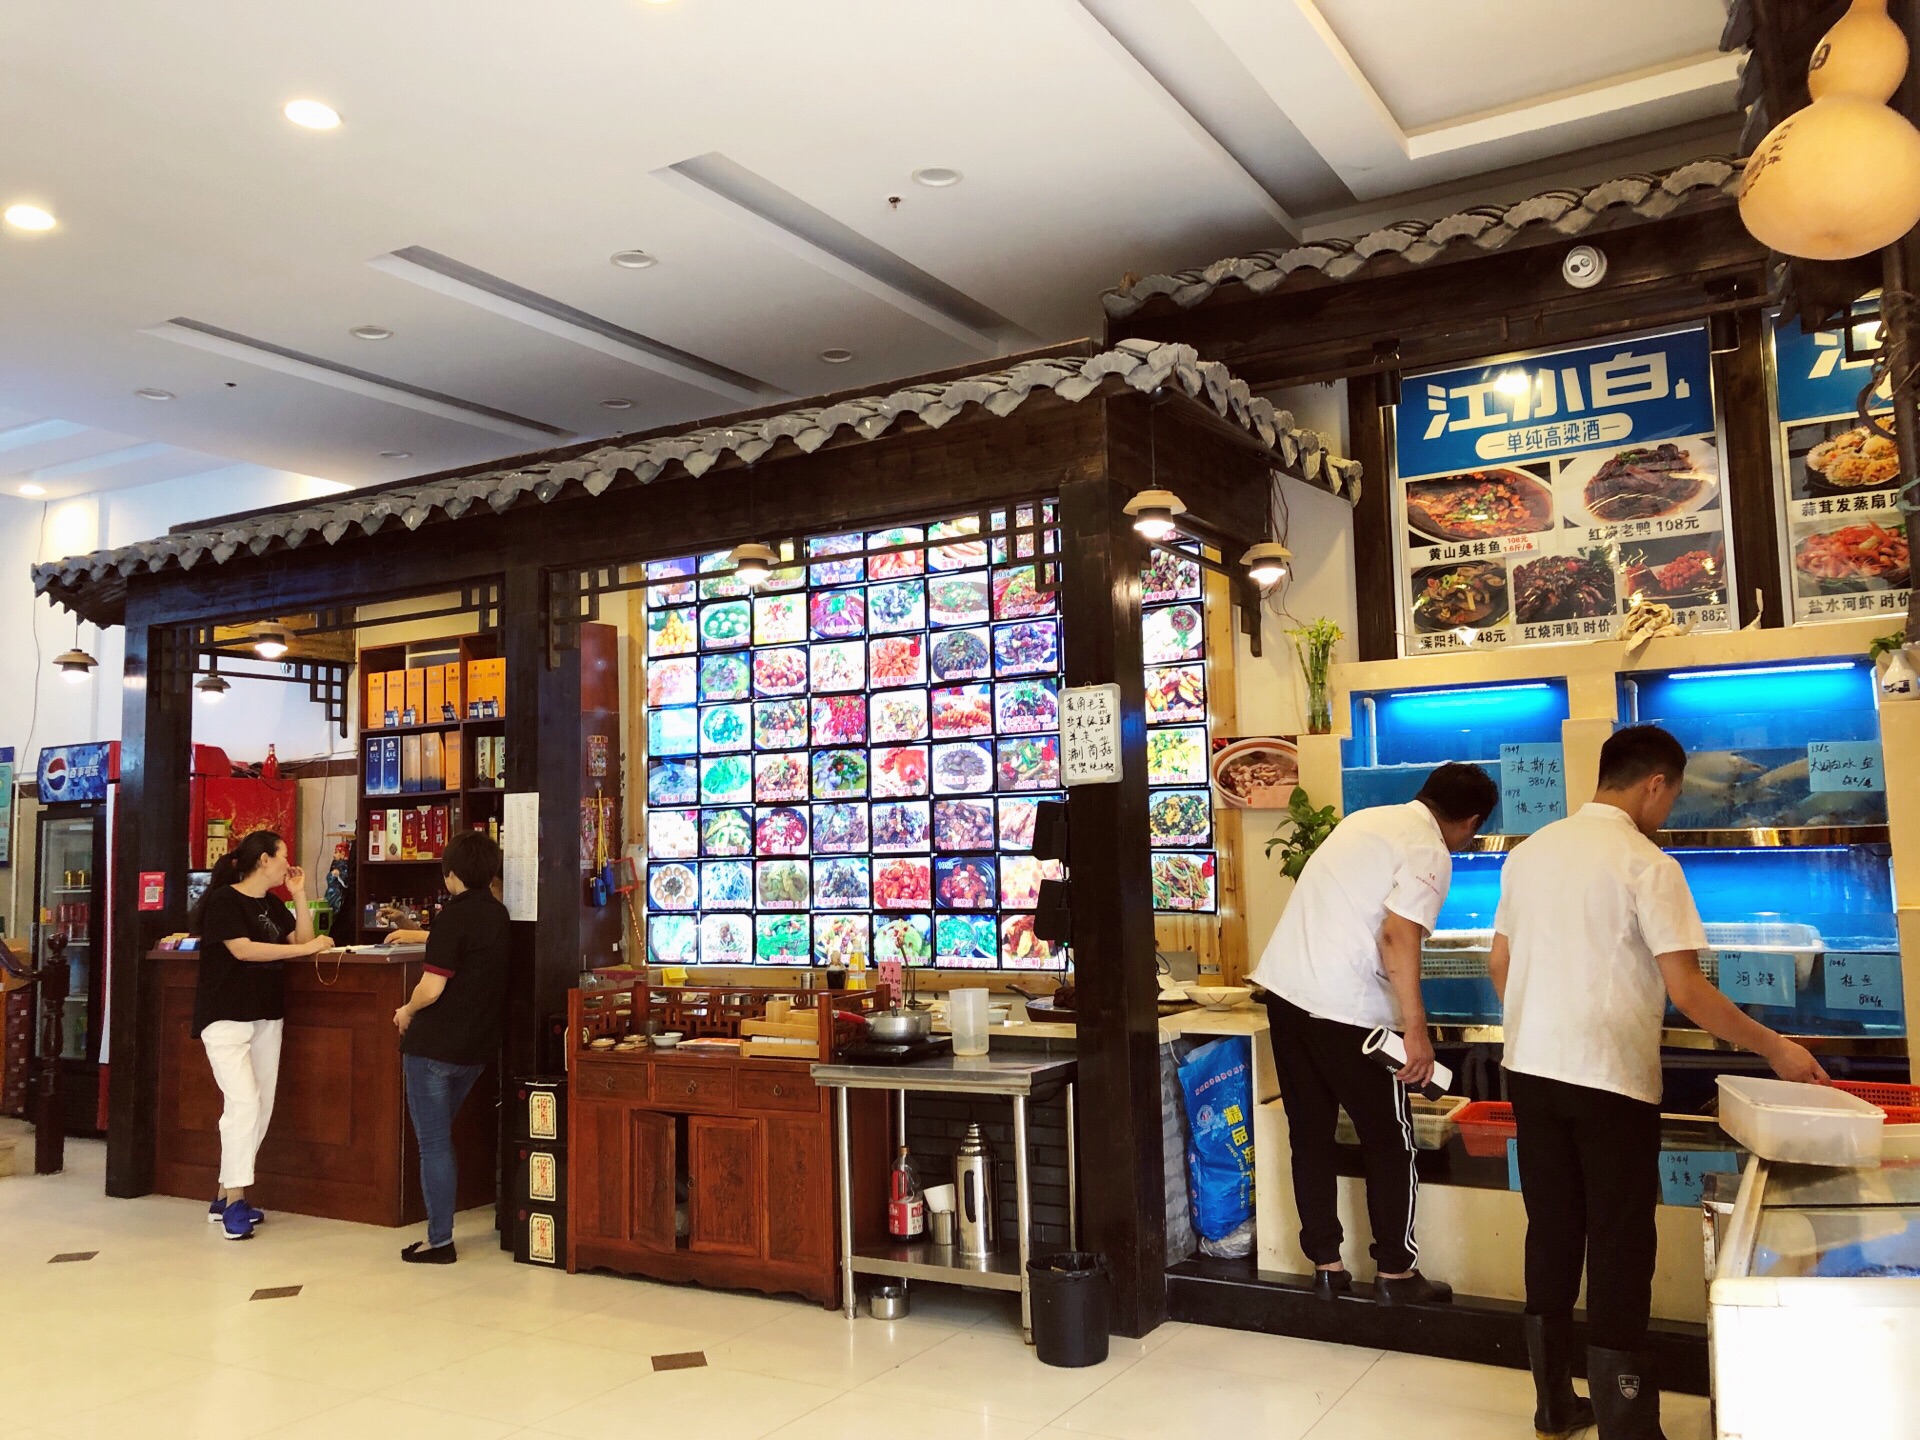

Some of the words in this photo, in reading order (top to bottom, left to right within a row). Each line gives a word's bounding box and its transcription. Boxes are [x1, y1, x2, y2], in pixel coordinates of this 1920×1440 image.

[1424, 351, 1669, 440] 江小白
[1507, 419, 1600, 453] 单纯高粱酒
[1588, 522, 1650, 541] 红烧老鸭
[1656, 516, 1699, 532] 108元
[1507, 536, 1529, 544] 108元
[1429, 541, 1501, 561] 黄山臭桂鱼
[1808, 594, 1875, 614] 盐水河虾
[1702, 608, 1726, 622] 88元
[1478, 630, 1506, 643] 48元
[1524, 620, 1580, 639] 红烧河鳗
[1583, 619, 1611, 633] 时价
[70, 766, 99, 778] 百事可乐
[1510, 757, 1560, 776] 波斯龙
